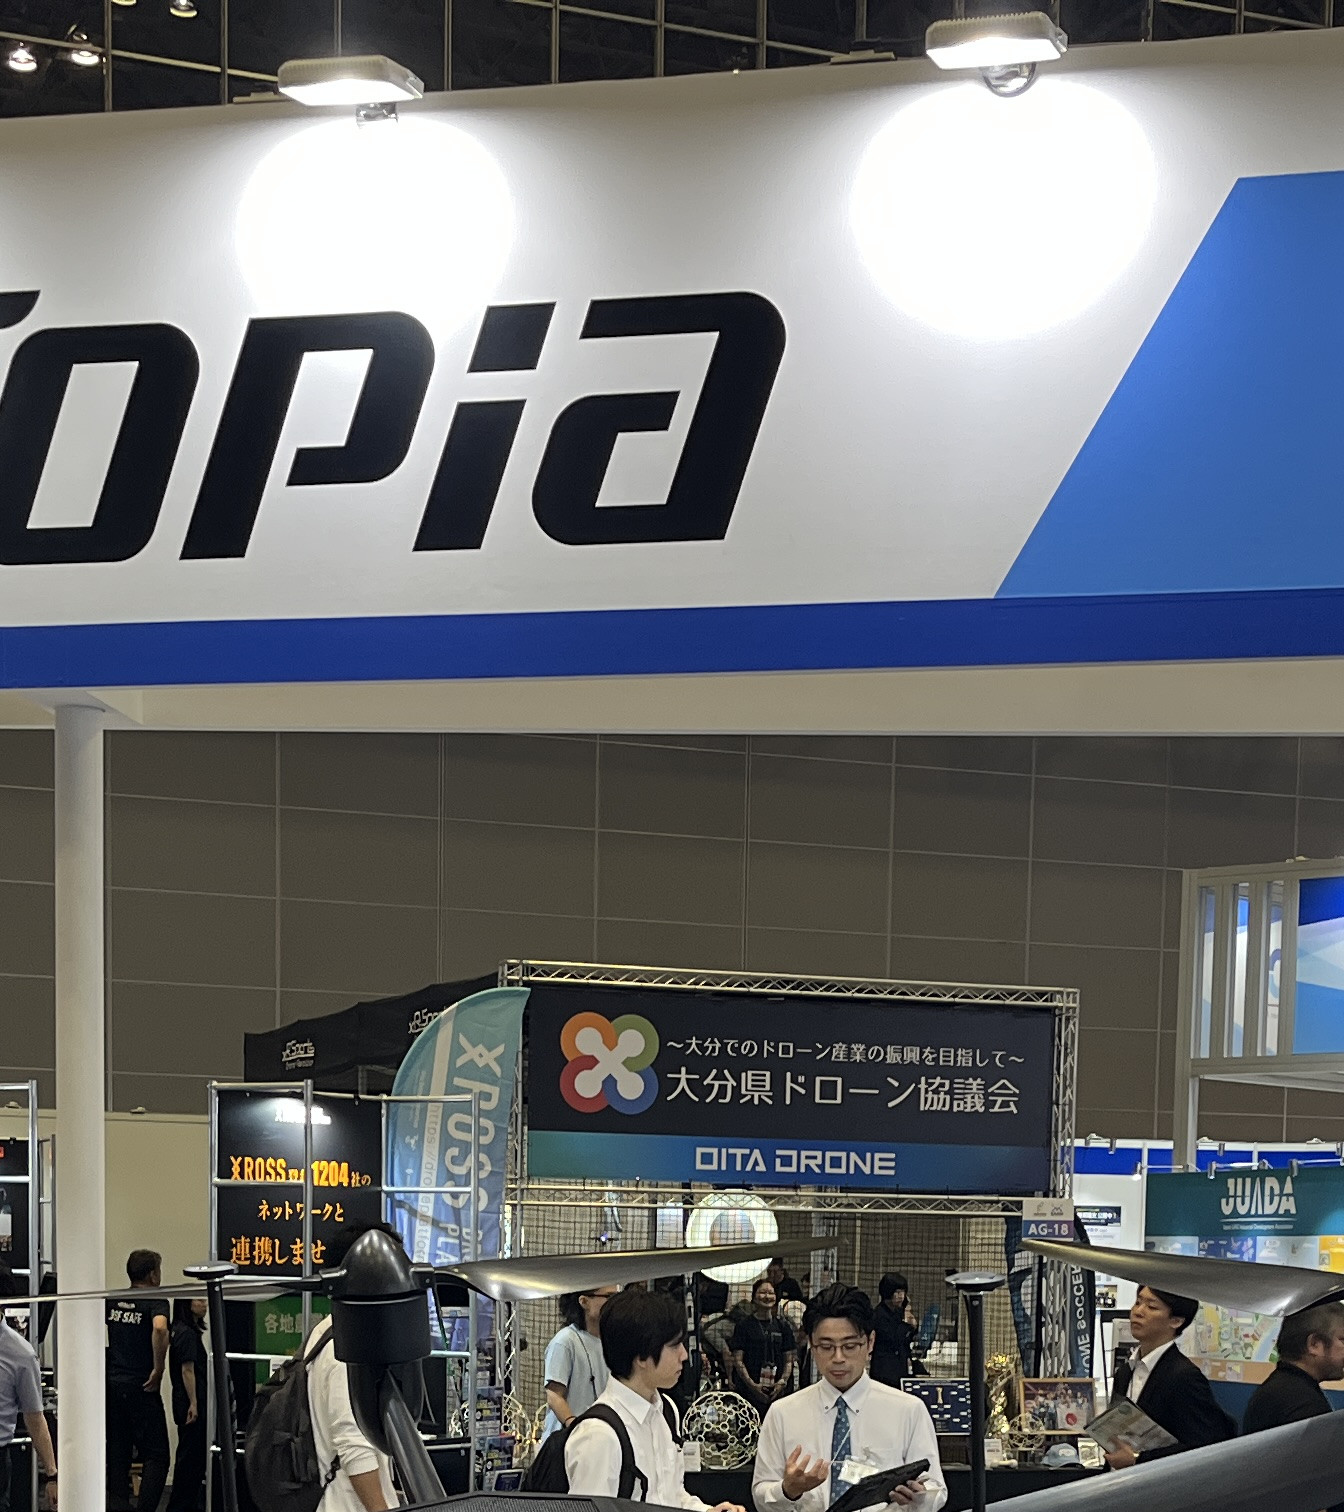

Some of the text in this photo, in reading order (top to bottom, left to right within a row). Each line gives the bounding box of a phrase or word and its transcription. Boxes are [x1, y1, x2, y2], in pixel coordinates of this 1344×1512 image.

[666, 1066, 1020, 1114] 大分県ドローン協議会
[696, 1147, 896, 1176] OITA DRONE
[1028, 1223, 1069, 1237] AG-18
